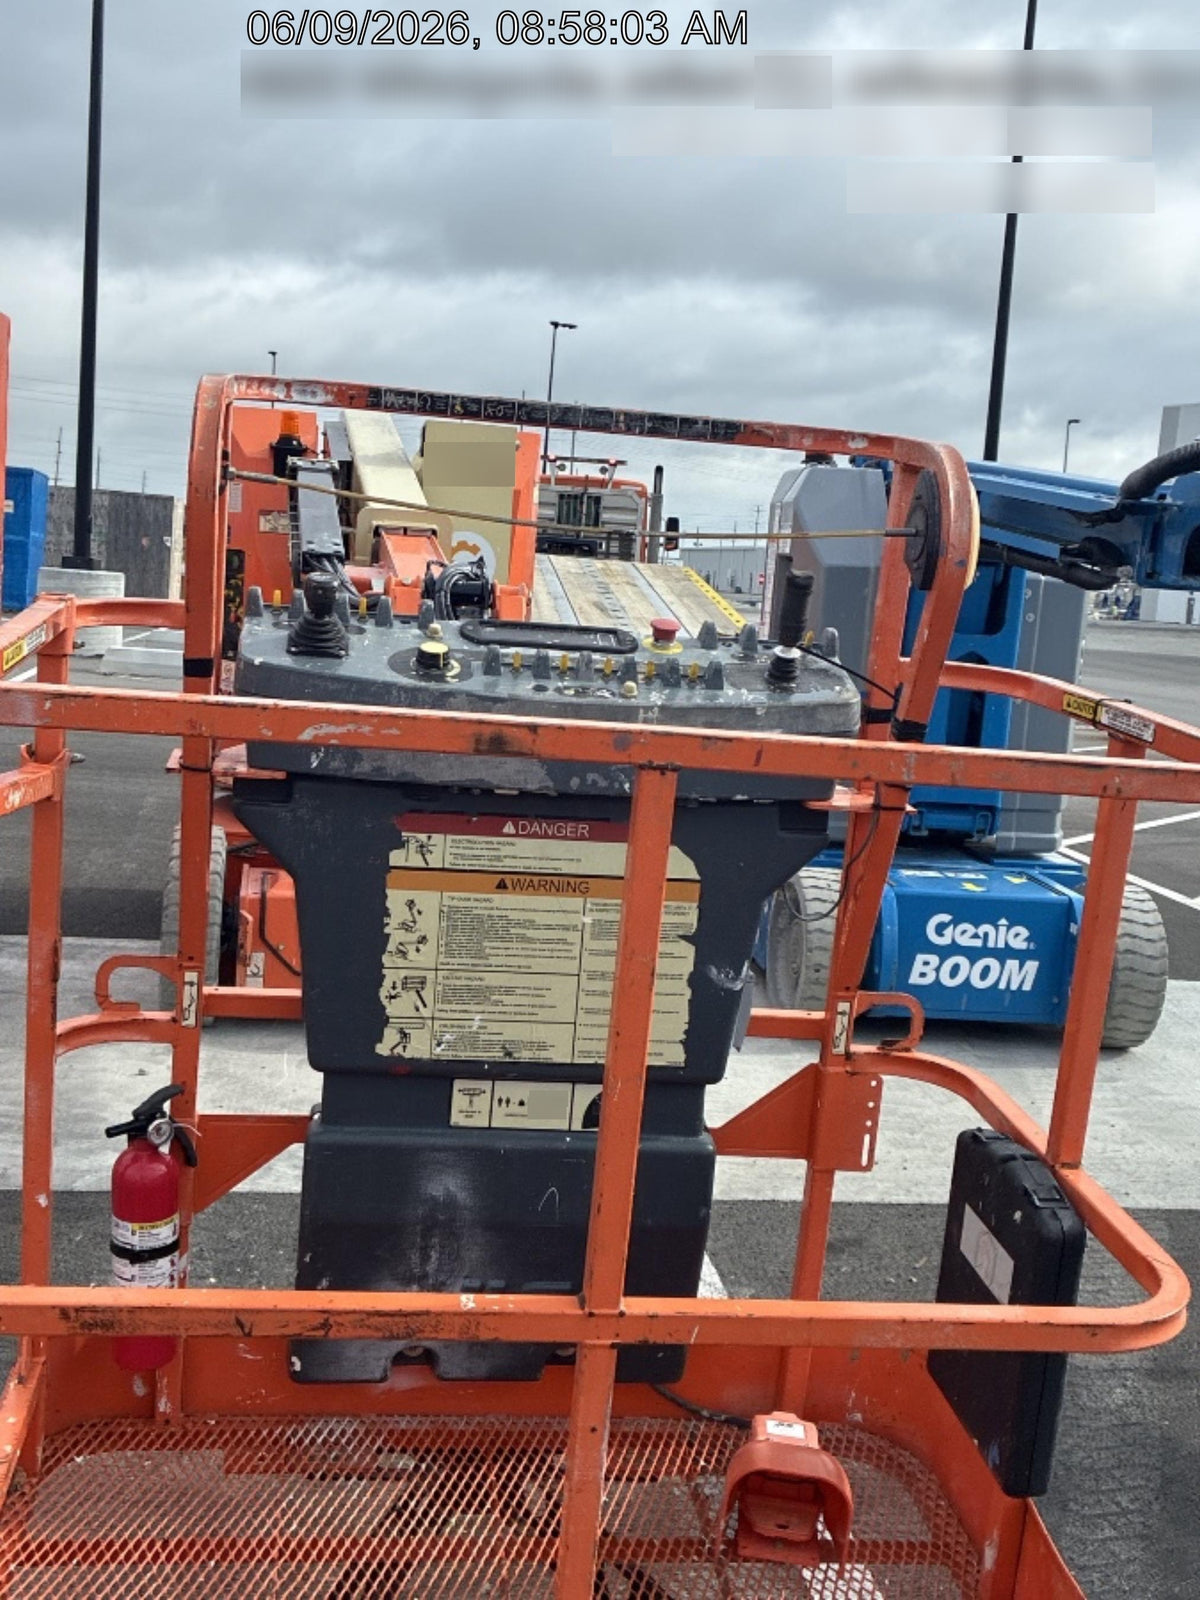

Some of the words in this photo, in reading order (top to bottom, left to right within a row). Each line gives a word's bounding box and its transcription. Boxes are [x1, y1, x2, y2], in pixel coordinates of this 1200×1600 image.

[518, 820, 590, 838] DANGER
[511, 877, 590, 895] WARNING
[926, 912, 1030, 951] Genie
[908, 953, 1040, 992] BOOM
